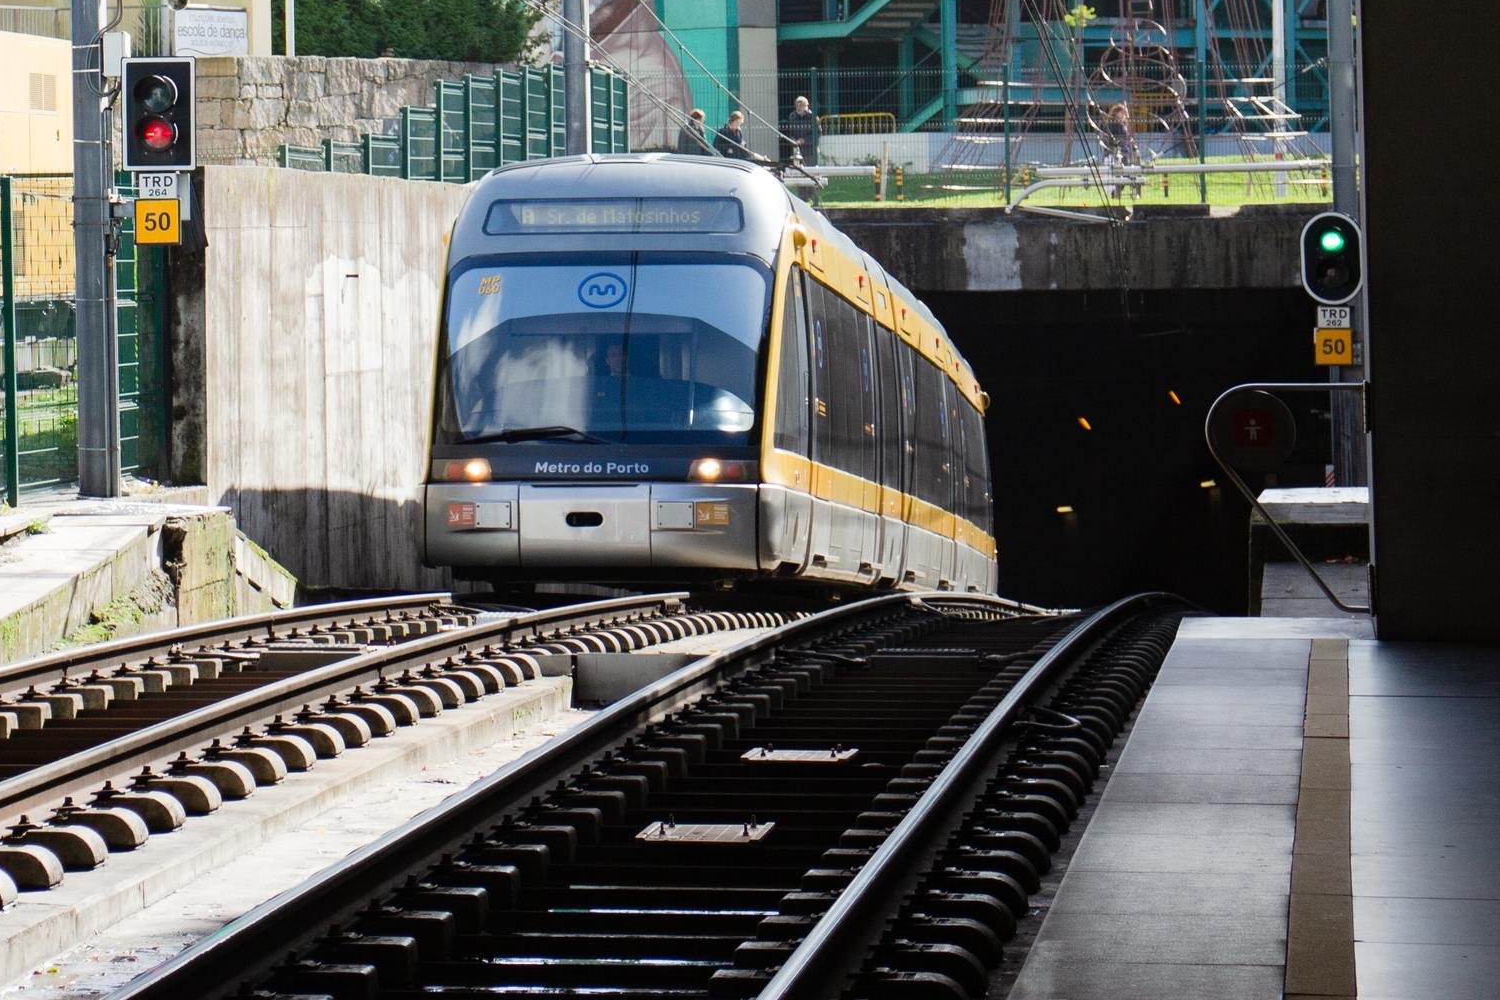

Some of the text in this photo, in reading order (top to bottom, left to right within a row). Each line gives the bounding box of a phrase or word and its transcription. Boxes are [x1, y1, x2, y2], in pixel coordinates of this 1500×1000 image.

[177, 23, 245, 41] escola de dança
[142, 175, 173, 188] TRD
[148, 188, 168, 197] 264
[144, 211, 171, 232] 50
[576, 208, 597, 225] de
[603, 208, 701, 224] Matosinhos
[1321, 308, 1348, 319] TRD
[1322, 338, 1345, 355] 50
[534, 461, 650, 474] Metro do Porto
